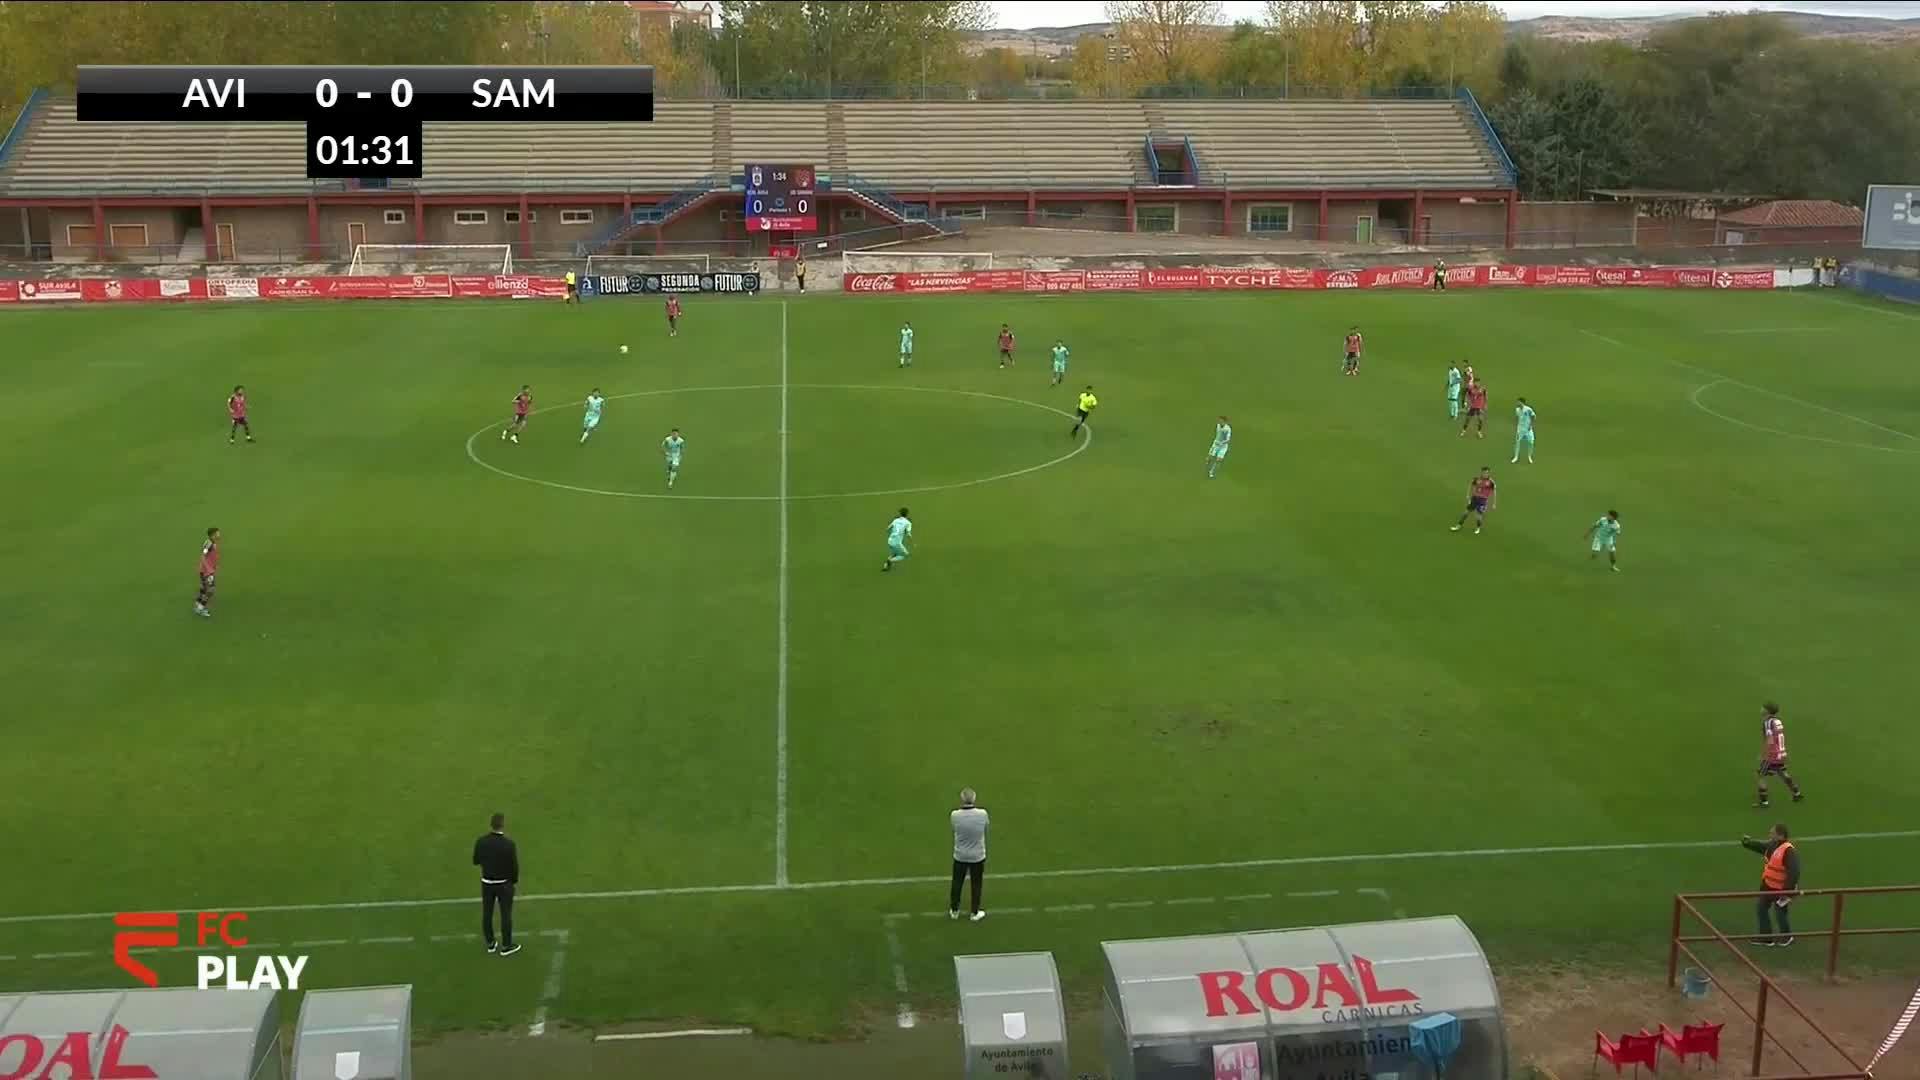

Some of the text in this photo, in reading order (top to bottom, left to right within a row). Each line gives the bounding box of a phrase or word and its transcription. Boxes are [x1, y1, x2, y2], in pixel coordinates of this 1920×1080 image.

[753, 200, 762, 213] 0
[798, 200, 807, 213] 0
[660, 274, 699, 287] SEGUNDA
[1196, 953, 1422, 1018] ROAL
[1321, 1002, 1424, 1024] CARNICAS
[981, 1047, 1055, 1062] Ayuntamiento
[1278, 1033, 1411, 1066] Ayuntamien
